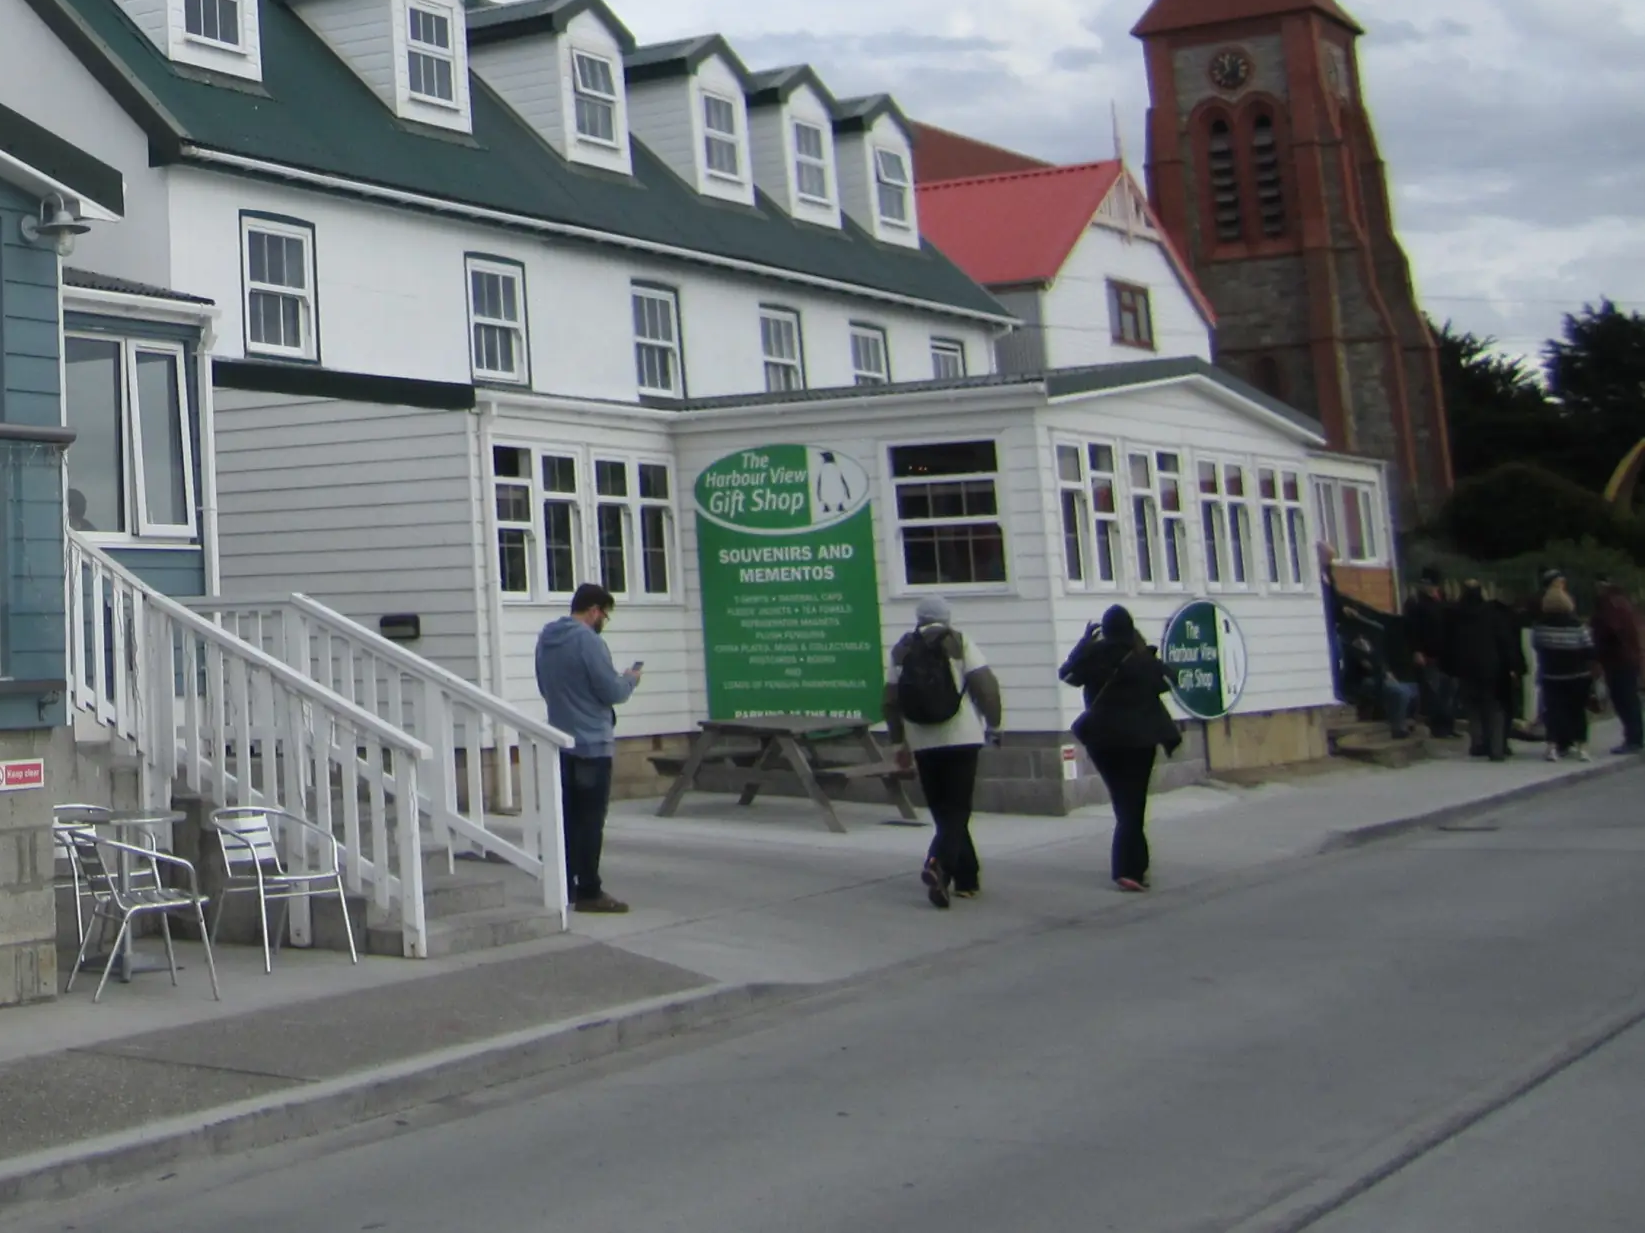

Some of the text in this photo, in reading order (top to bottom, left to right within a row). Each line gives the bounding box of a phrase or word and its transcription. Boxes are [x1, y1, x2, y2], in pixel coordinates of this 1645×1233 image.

[741, 451, 769, 469] The
[705, 466, 807, 488] Harbour View
[709, 487, 804, 518] Gift Shop
[718, 543, 853, 564] SOUVENIRS AND
[739, 565, 835, 583] MEMENTOS
[1185, 620, 1200, 639] The
[1168, 642, 1217, 662] Harbour View
[1178, 668, 1213, 691] Gift Shop
[7, 768, 40, 780] Keep clear
